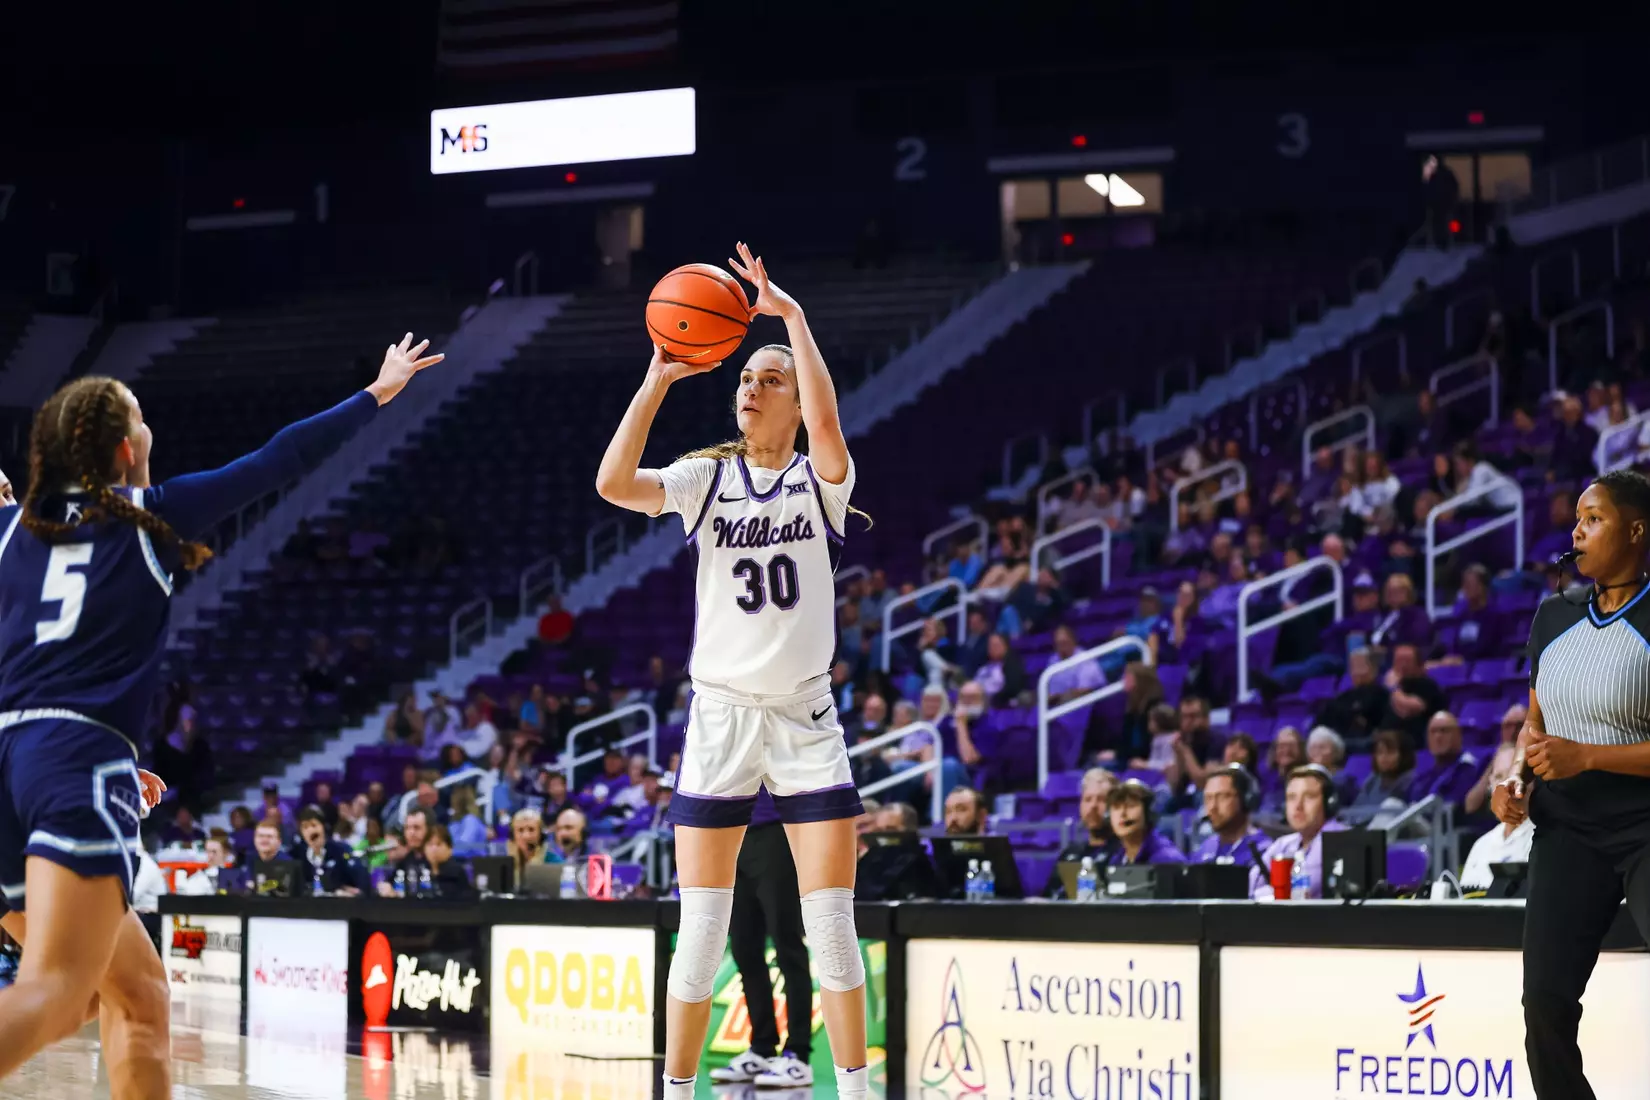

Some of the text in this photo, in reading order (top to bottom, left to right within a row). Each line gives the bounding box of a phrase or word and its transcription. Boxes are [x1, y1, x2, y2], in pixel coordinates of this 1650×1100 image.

[895, 137, 926, 180] 2
[1277, 113, 1310, 157] 3
[314, 183, 329, 224] 1
[713, 511, 816, 549] Wildcats
[35, 542, 94, 645] 5
[732, 553, 801, 615] 30
[439, 958, 482, 1013] Hut
[504, 947, 648, 1024] QDOBA
[1001, 956, 1184, 1021] Ascension
[1001, 1038, 1193, 1100] Via Christi
[1336, 1048, 1513, 1099] FREEDOM
